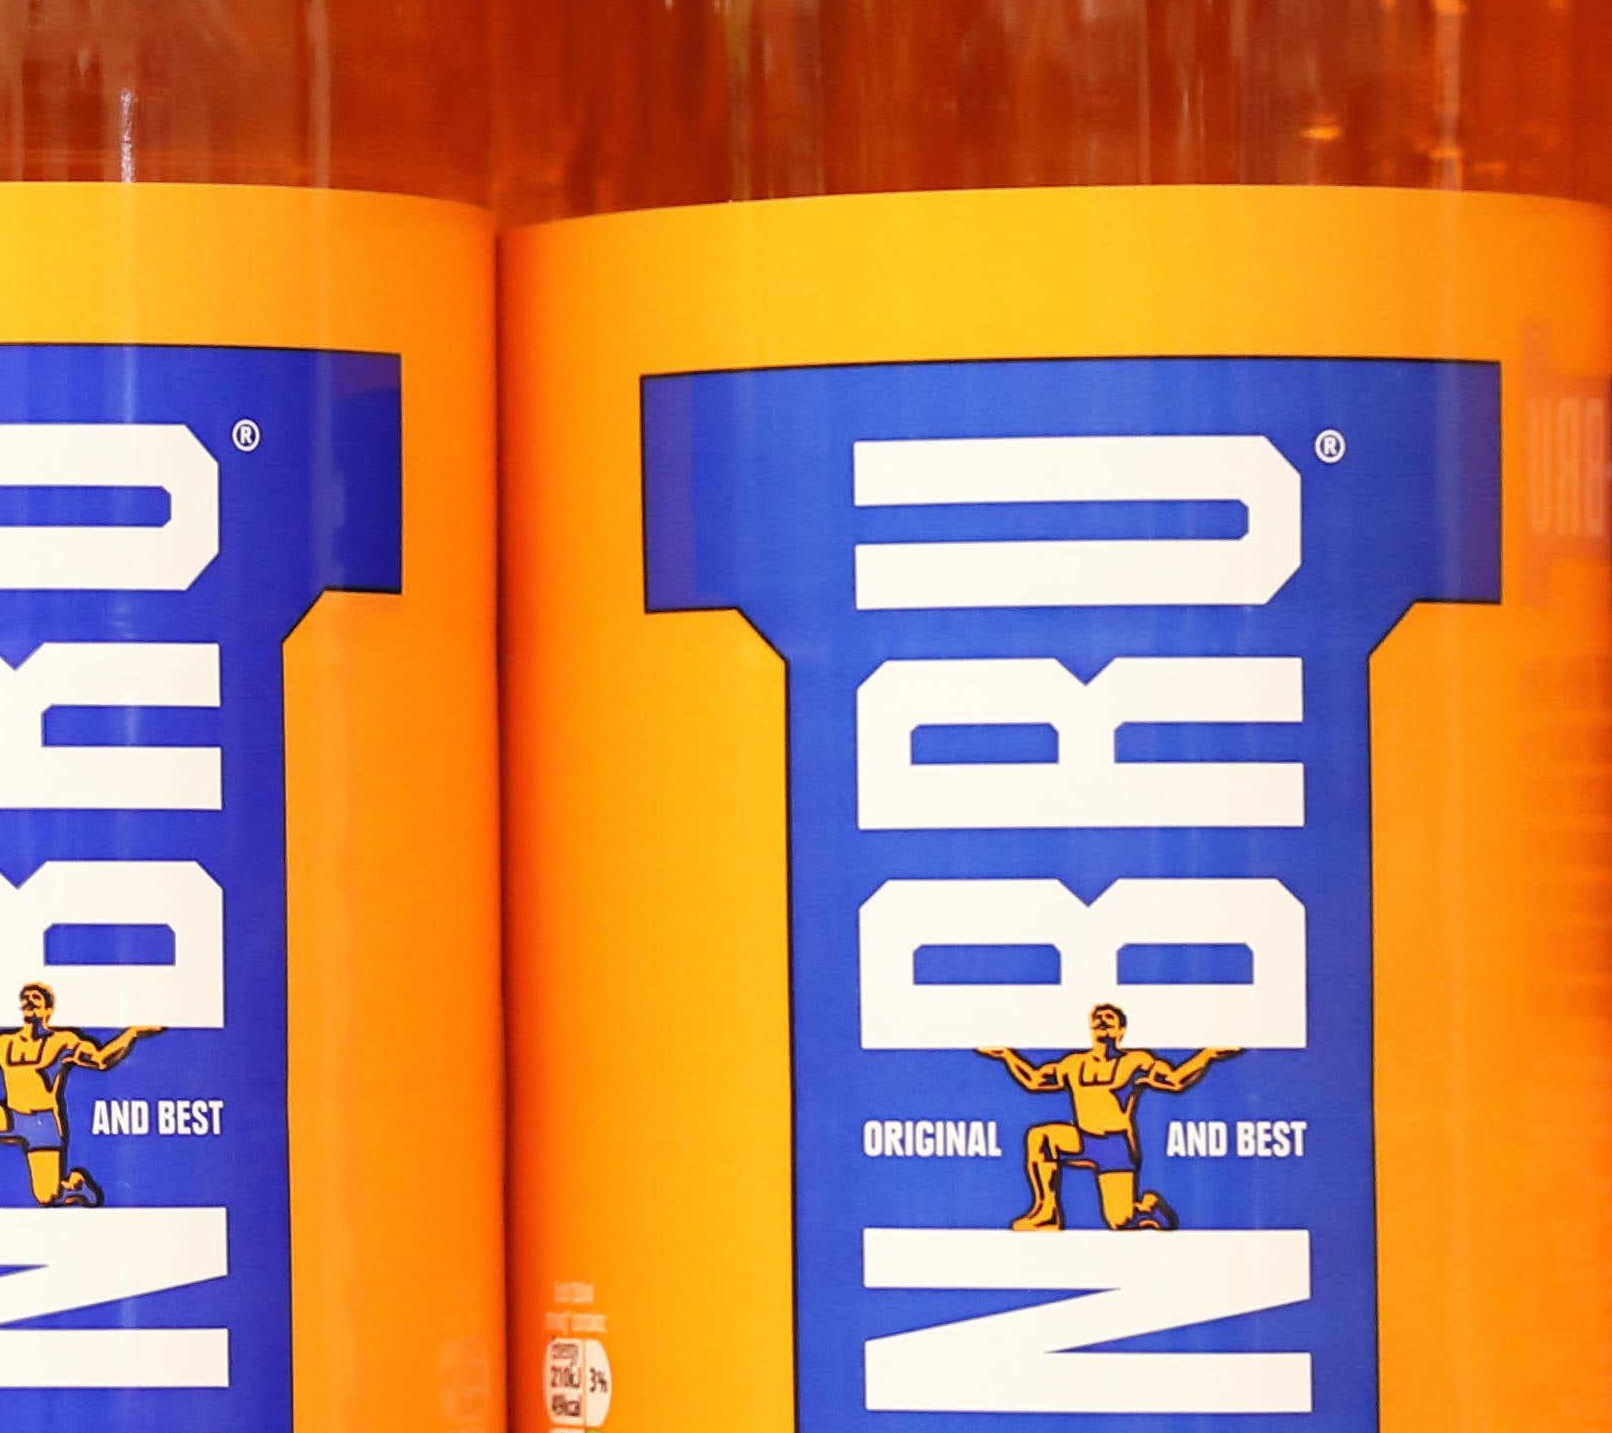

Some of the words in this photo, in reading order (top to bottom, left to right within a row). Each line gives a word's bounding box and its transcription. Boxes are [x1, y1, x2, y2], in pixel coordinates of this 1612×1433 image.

[854, 436, 1306, 1050] BRU
[93, 1100, 148, 1134] AND
[159, 1101, 223, 1134] BEST
[864, 1121, 1001, 1156] ORIGINAL
[1167, 1122, 1227, 1156] AND
[1237, 1121, 1307, 1157] BEST
